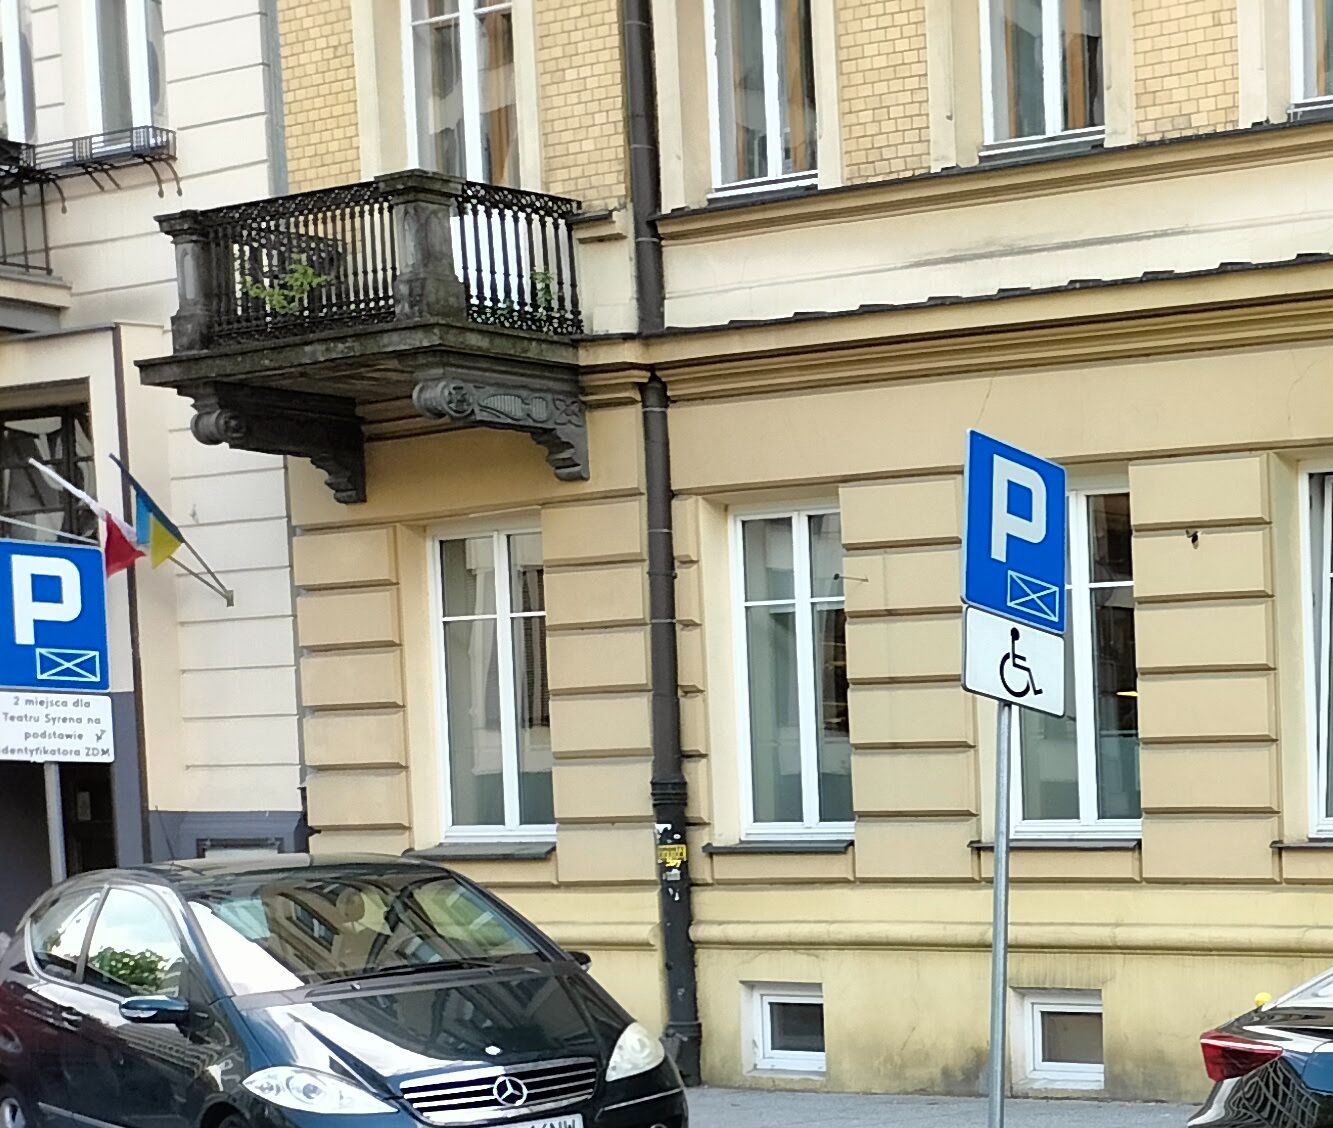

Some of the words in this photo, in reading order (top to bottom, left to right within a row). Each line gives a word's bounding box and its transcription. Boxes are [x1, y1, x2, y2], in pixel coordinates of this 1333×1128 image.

[991, 453, 1046, 563] P
[11, 554, 82, 645] P
[13, 696, 20, 706] 2
[25, 697, 68, 709] miejsca
[72, 698, 91, 708] dla
[2, 712, 40, 723] Teatru
[44, 713, 83, 726] Syrena
[87, 716, 101, 725] na
[24, 730, 84, 741] podstawie
[0, 746, 81, 757] dentyfikatora
